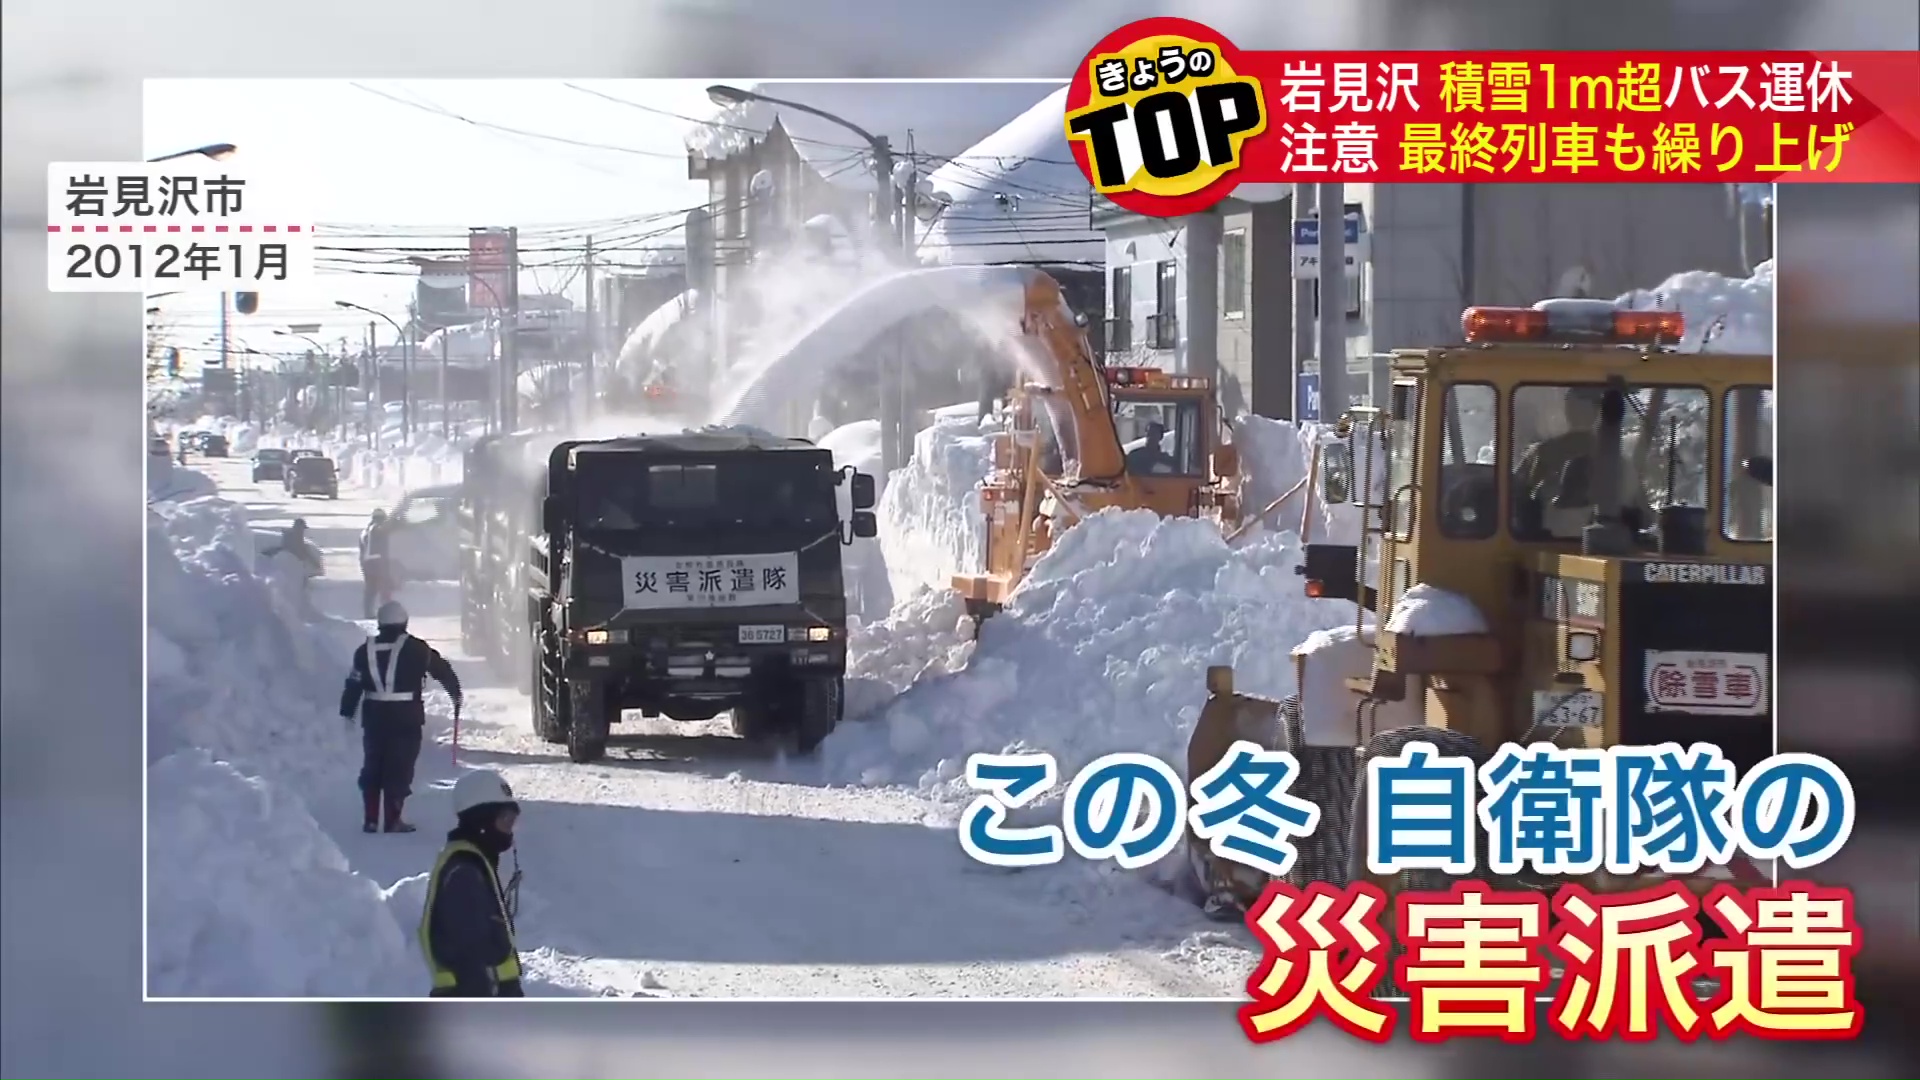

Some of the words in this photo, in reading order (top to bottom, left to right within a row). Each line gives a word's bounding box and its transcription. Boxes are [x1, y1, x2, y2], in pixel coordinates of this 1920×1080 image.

[635, 567, 787, 594] 災害派遣隊
[1644, 563, 1766, 585] CATERPILLAR
[1658, 669, 1754, 700] 除雪車
